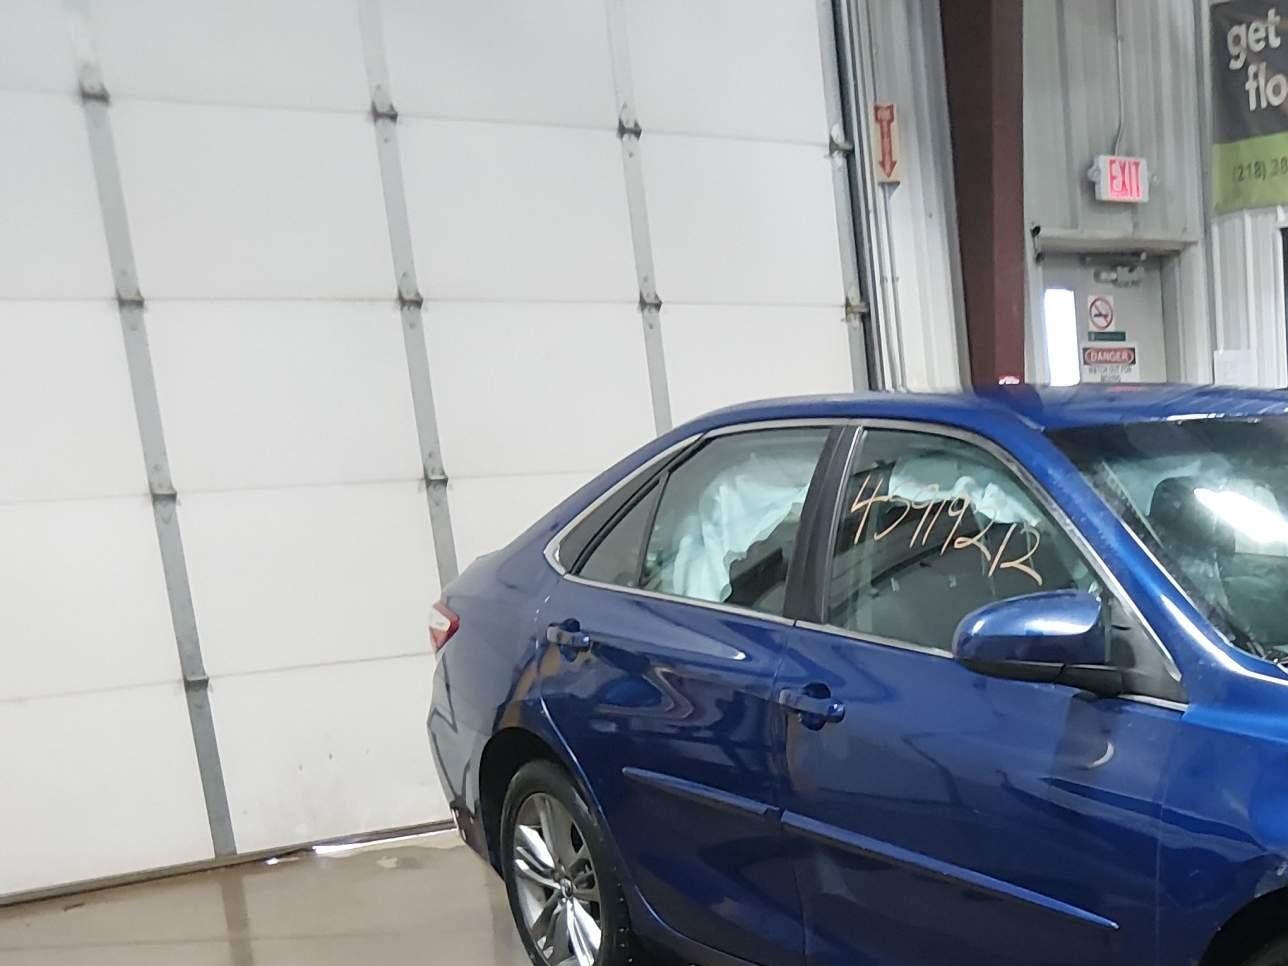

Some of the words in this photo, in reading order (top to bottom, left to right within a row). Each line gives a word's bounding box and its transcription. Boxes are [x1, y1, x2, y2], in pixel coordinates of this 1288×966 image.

[1227, 8, 1281, 70] get
[1109, 159, 1140, 198] EXIT
[1233, 160, 1266, 181] (218)
[1091, 351, 1129, 361] DANGER
